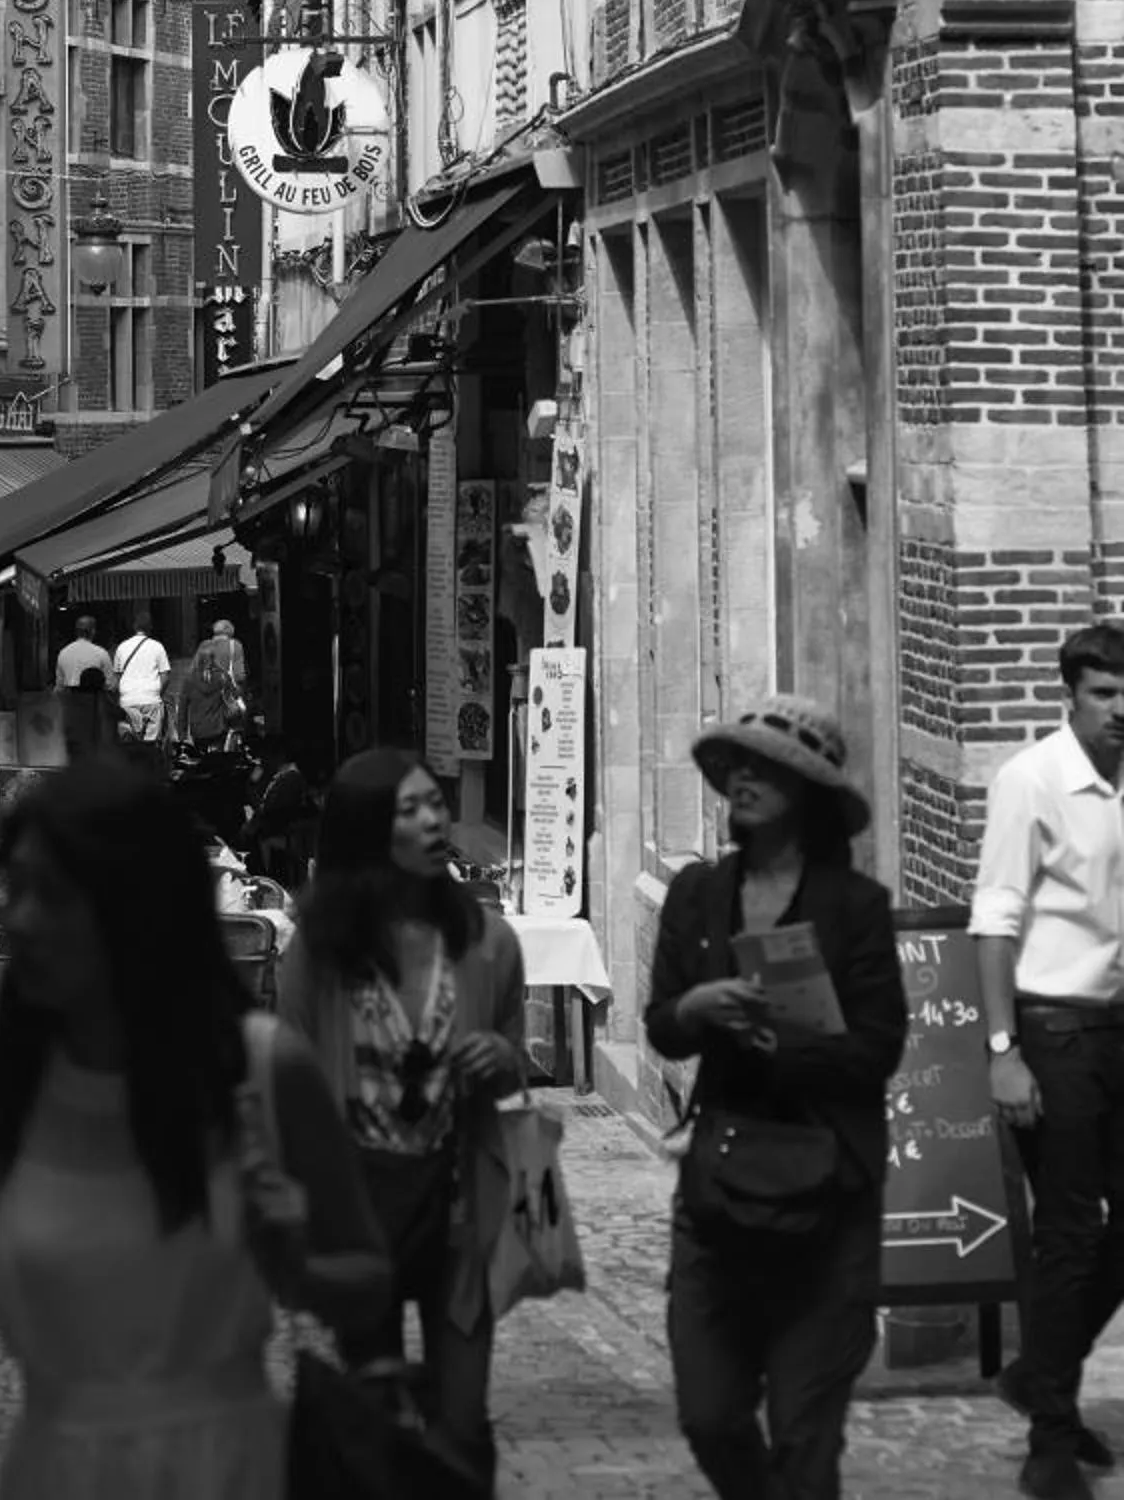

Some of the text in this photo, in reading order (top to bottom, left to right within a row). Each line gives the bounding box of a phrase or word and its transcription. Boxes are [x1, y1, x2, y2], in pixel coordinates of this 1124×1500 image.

[239, 144, 382, 206] GRILL AU FEU DE BOIS
